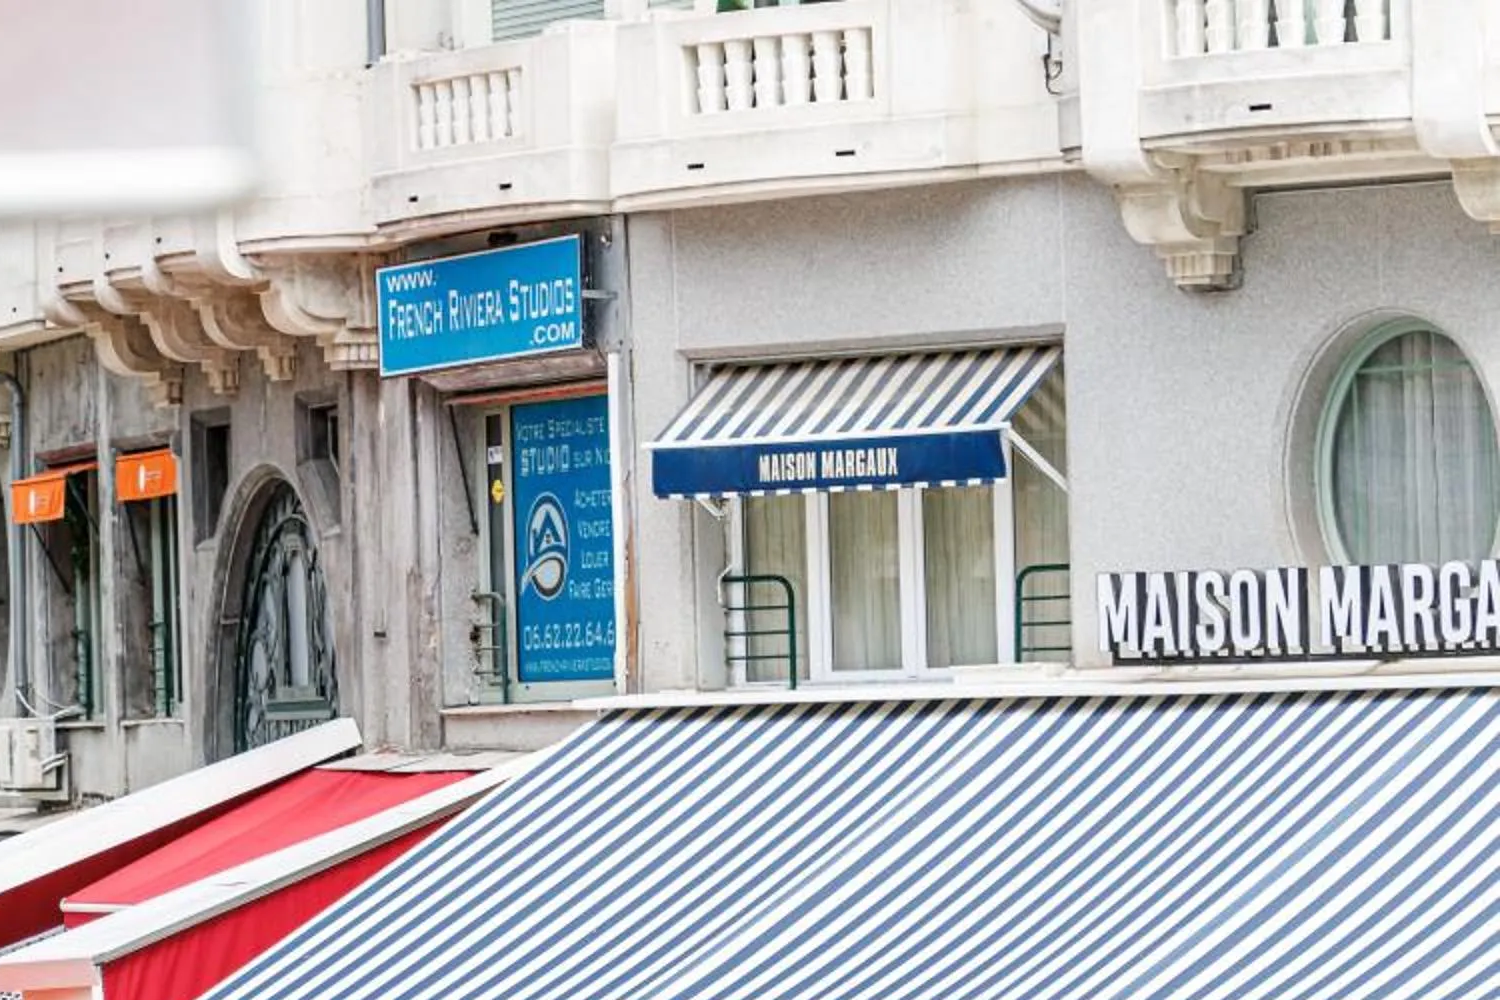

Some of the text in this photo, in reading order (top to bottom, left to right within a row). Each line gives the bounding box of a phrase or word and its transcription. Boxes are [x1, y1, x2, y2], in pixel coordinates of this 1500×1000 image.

[388, 277, 575, 340] FRENCH RIVIERA STUDIOS
[521, 444, 570, 477] STUDIO
[759, 447, 899, 483] MAISON MARGAUX
[1098, 566, 1306, 658] MAISON
